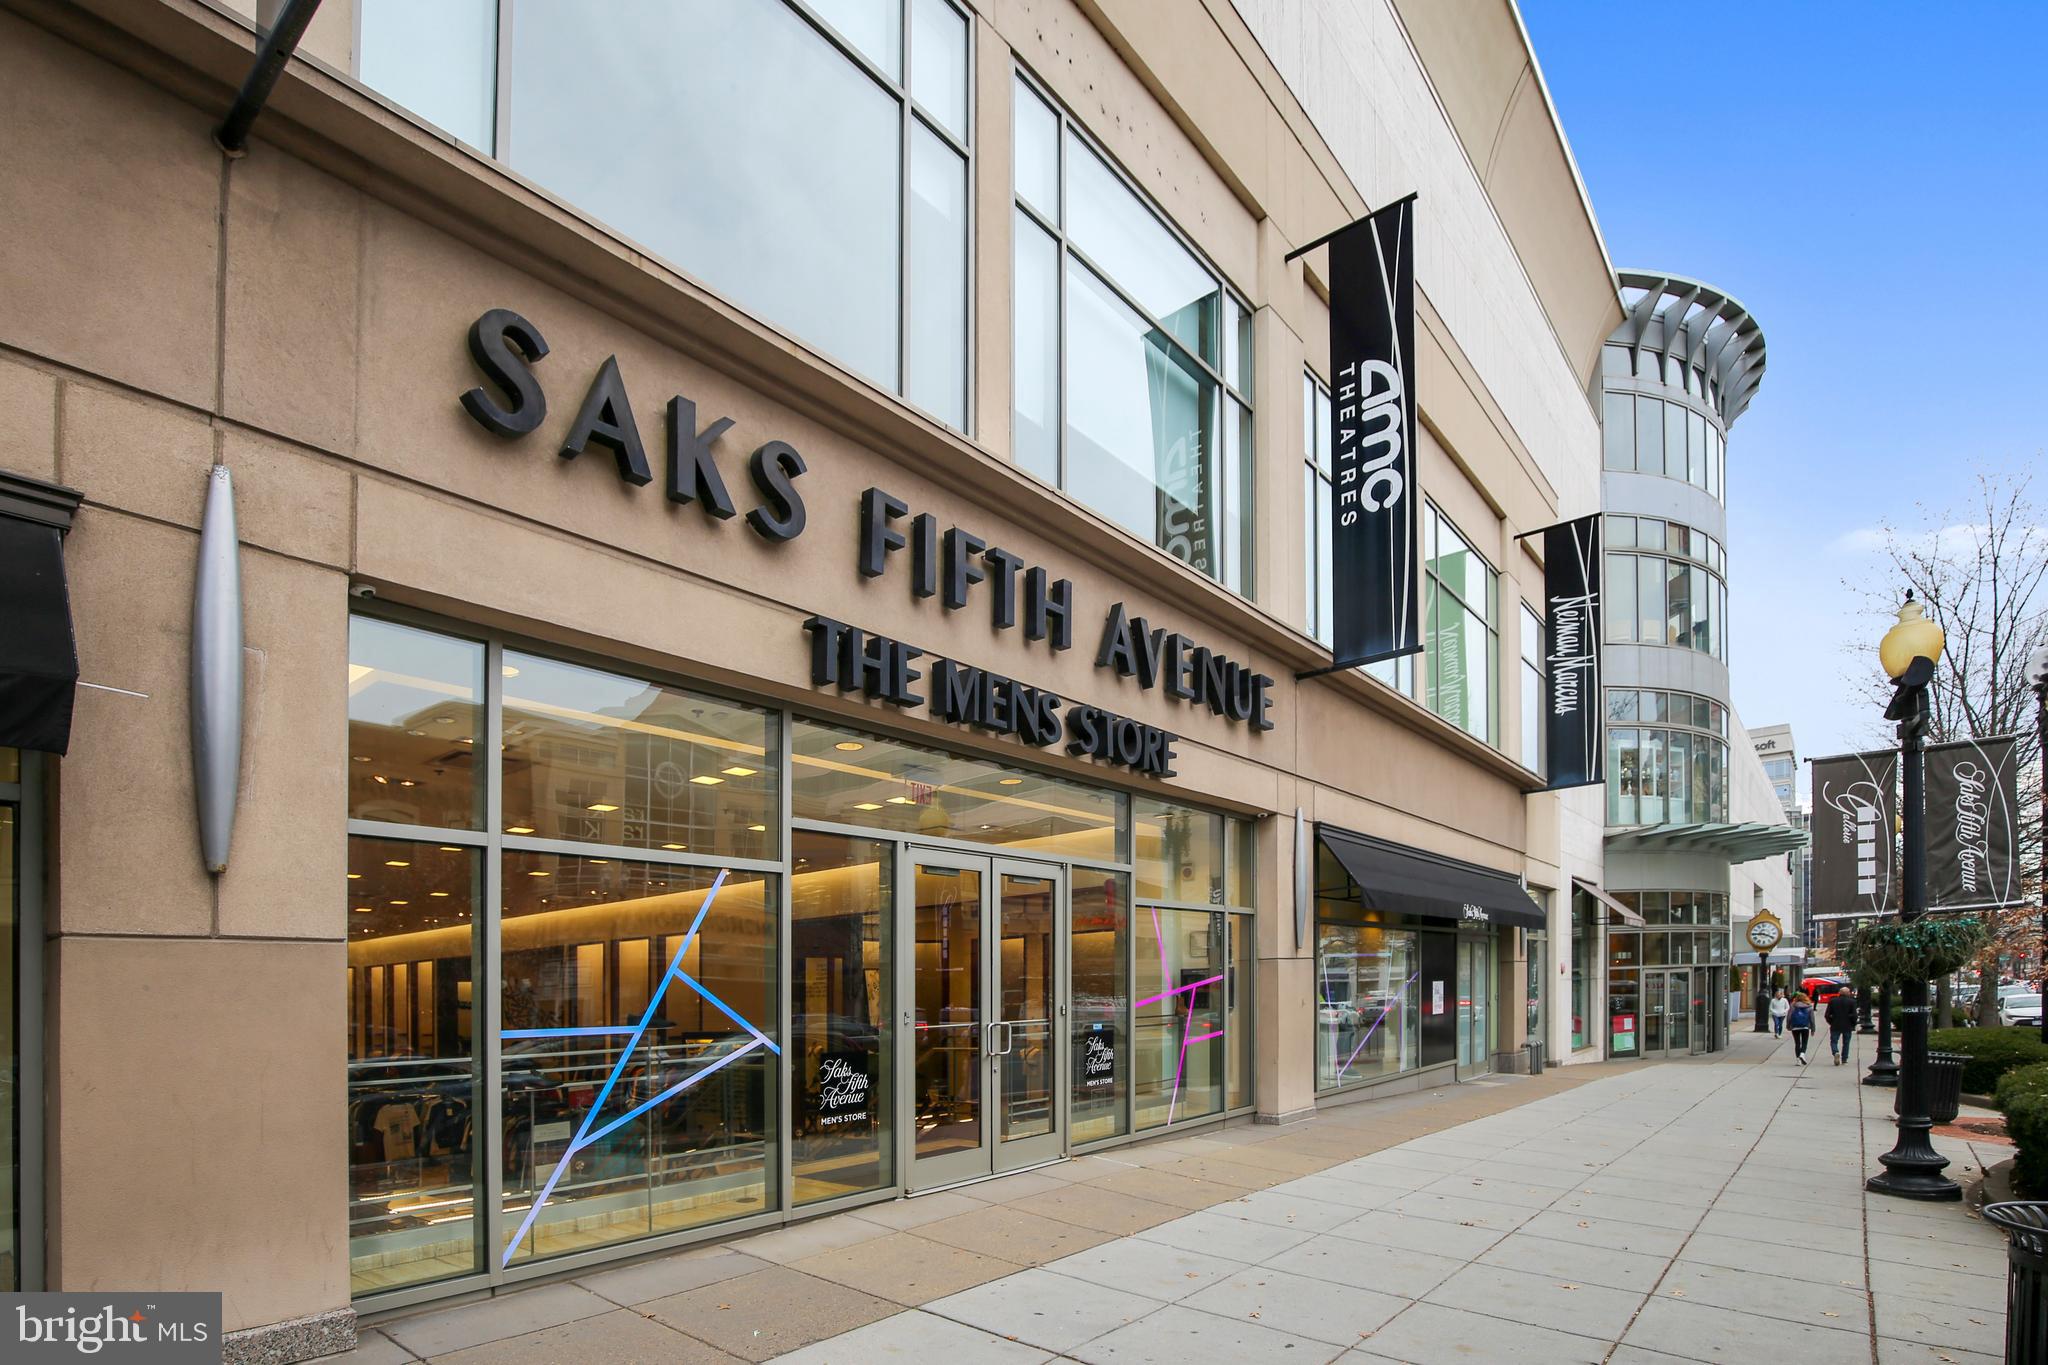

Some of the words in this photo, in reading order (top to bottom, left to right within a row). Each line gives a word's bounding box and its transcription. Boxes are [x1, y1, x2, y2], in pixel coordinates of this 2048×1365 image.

[1339, 361, 1357, 527] THEATRES
[1361, 360, 1402, 513] amc
[459, 308, 808, 543] SAKS
[860, 487, 1072, 651] FIFTH
[1097, 601, 1275, 730] AVENUE
[1550, 592, 1599, 657] Neiman
[803, 615, 925, 708] THE
[930, 657, 1062, 747] MENS
[1065, 704, 1178, 778] STORE
[1546, 654, 1597, 716] Marcus
[1953, 761, 1986, 804] Saks
[1955, 831, 1988, 893] Avenue
[819, 1058, 852, 1084] Saks
[819, 1086, 865, 1110] Avenue
[821, 1115, 843, 1126] MEN'S
[844, 1112, 867, 1122] STORE
